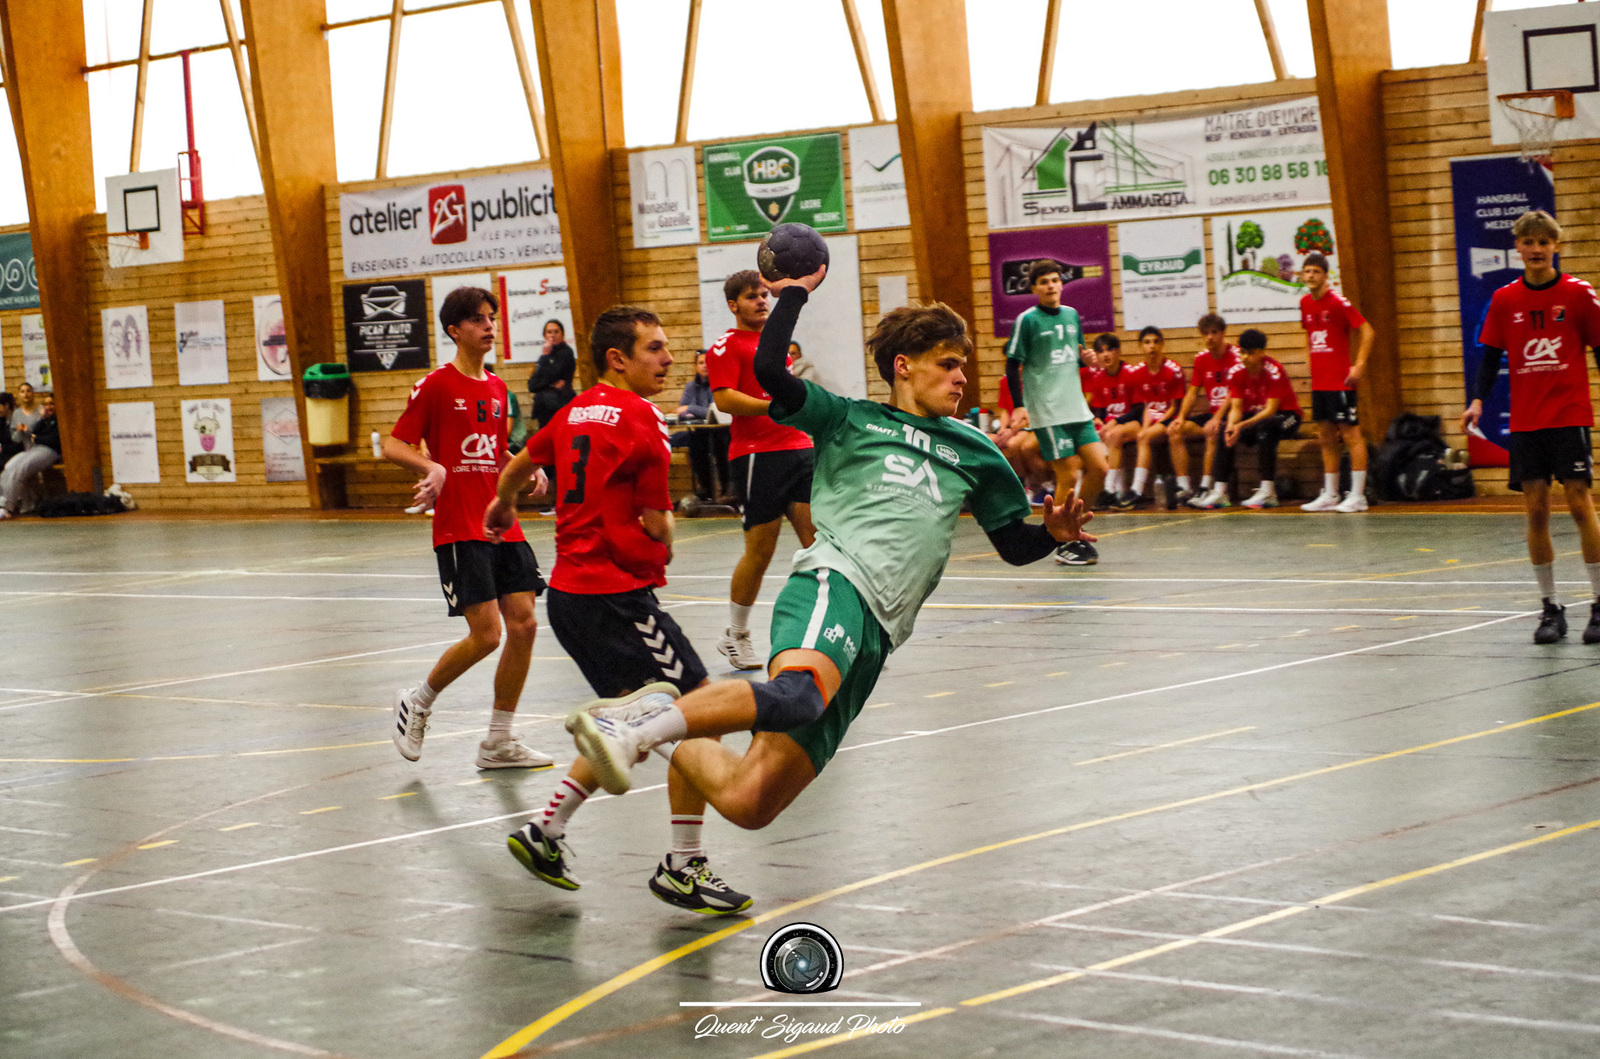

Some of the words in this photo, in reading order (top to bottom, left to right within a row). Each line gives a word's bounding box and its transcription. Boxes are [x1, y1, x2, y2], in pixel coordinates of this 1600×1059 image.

[753, 158, 792, 180] HBC
[1208, 168, 1230, 186] 06
[1235, 166, 1256, 183] 30
[1261, 164, 1283, 181] 98
[1287, 161, 1309, 179] 58
[637, 202, 678, 215] Monastier
[1476, 193, 1529, 205] HANDBALL
[350, 203, 422, 235] atelier
[1476, 207, 1503, 218] CLUB
[351, 257, 408, 274] ENSEIGNES
[420, 247, 506, 266] AUTOCOLLANTS
[1138, 258, 1186, 274] EYRAUD
[1529, 310, 1545, 330] 11
[866, 423, 893, 435] CRAFT
[902, 423, 931, 453] 10
[453, 465, 471, 473] LOIRE
[563, 435, 591, 504] 3
[881, 453, 943, 503] SA
